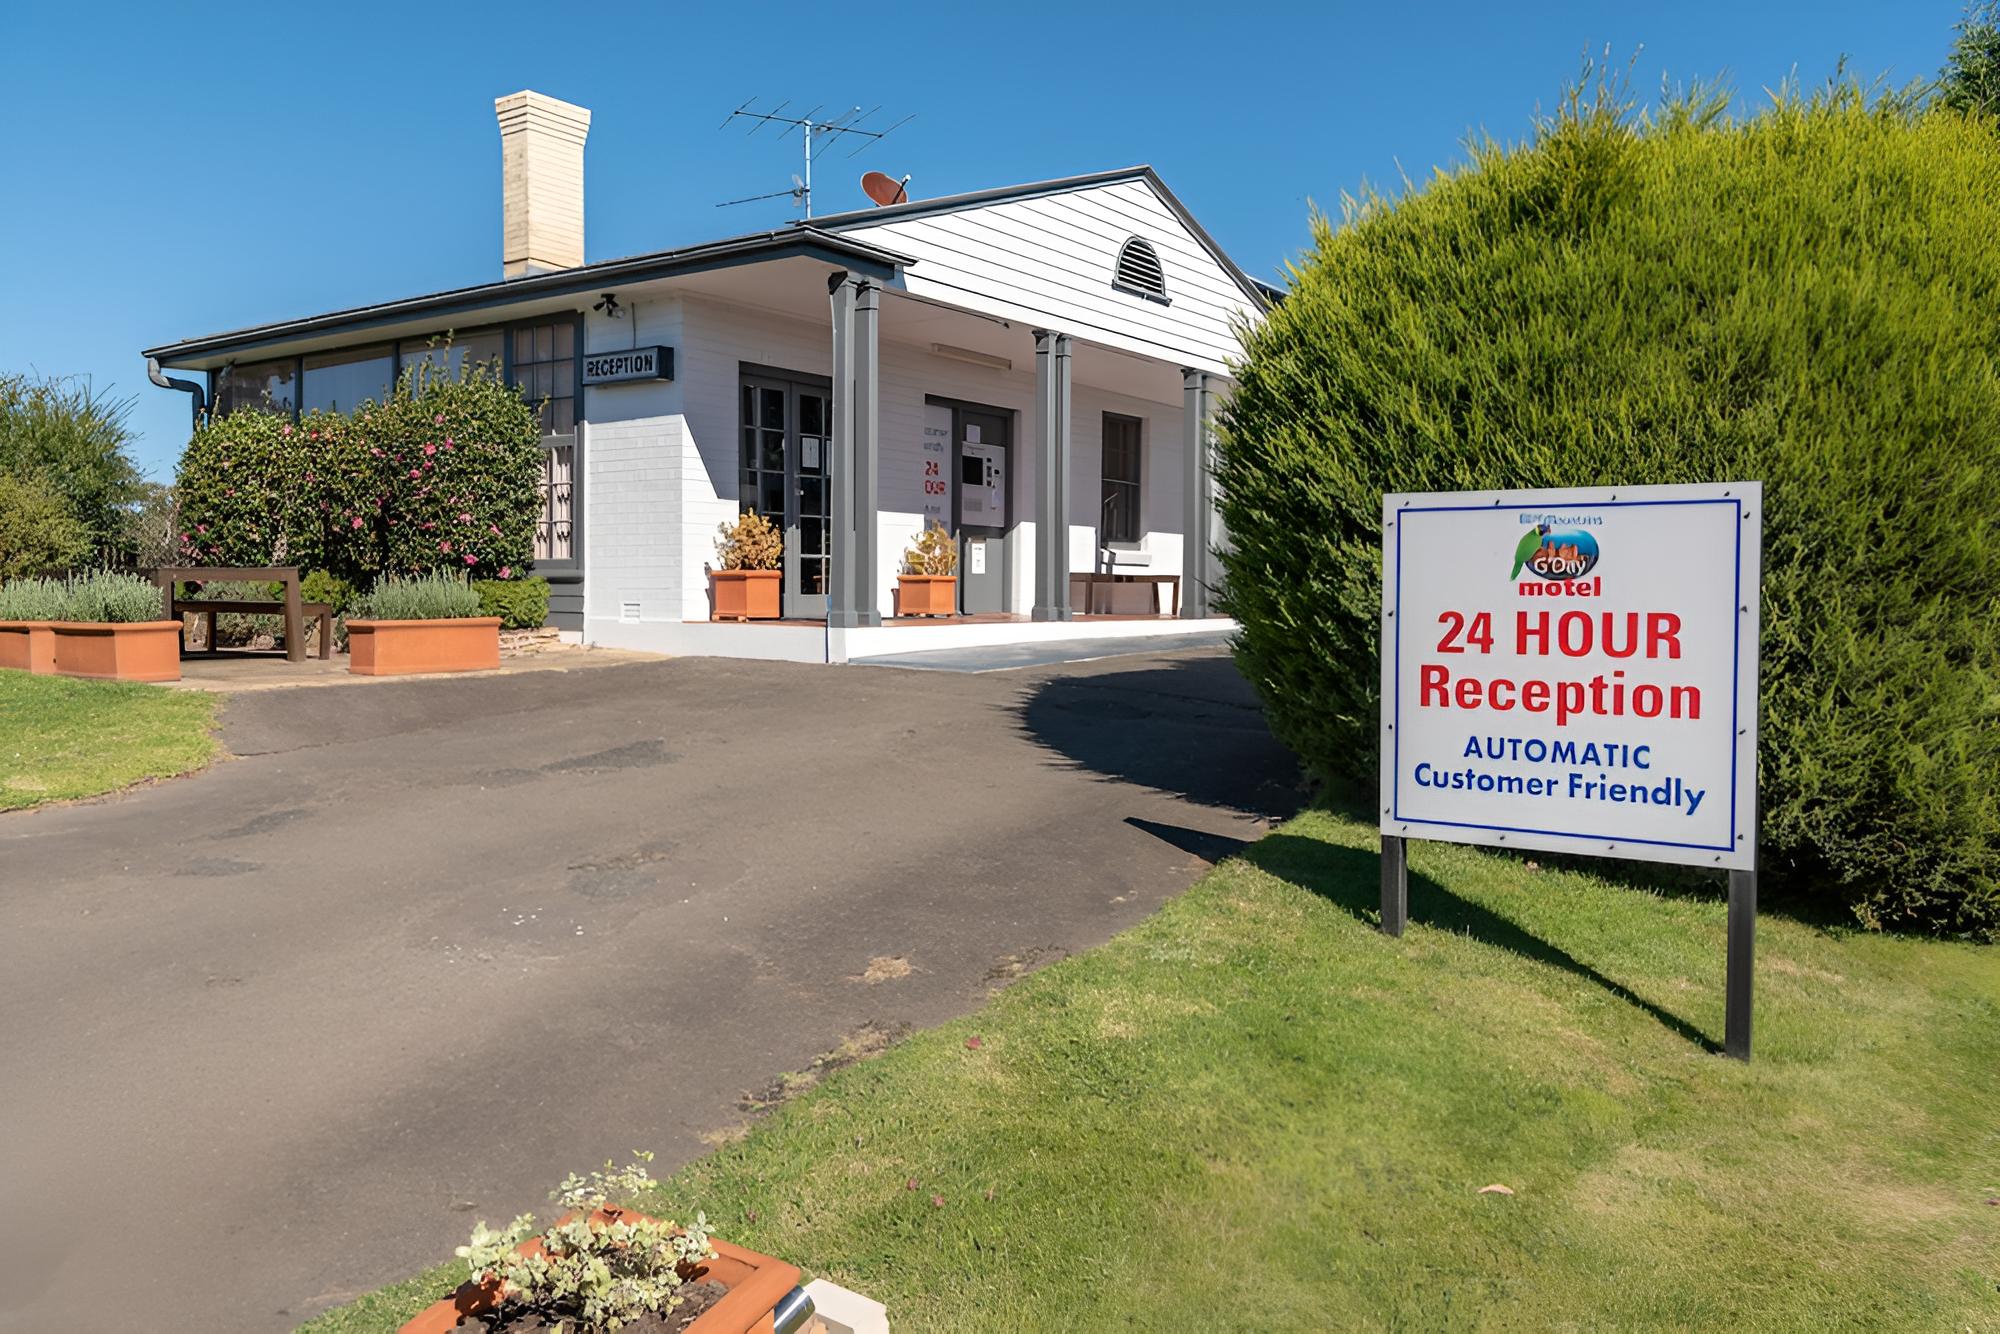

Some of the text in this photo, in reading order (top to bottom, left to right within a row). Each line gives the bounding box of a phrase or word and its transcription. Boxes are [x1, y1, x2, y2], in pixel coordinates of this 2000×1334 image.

[586, 354, 653, 377] RECEPTION
[1519, 576, 1601, 597] motel
[1436, 610, 1682, 660] 24 HOUR
[1419, 663, 1701, 727] Reception
[1463, 735, 1651, 769] AUTOMATIC
[1414, 762, 1706, 816] Customer Friendly
